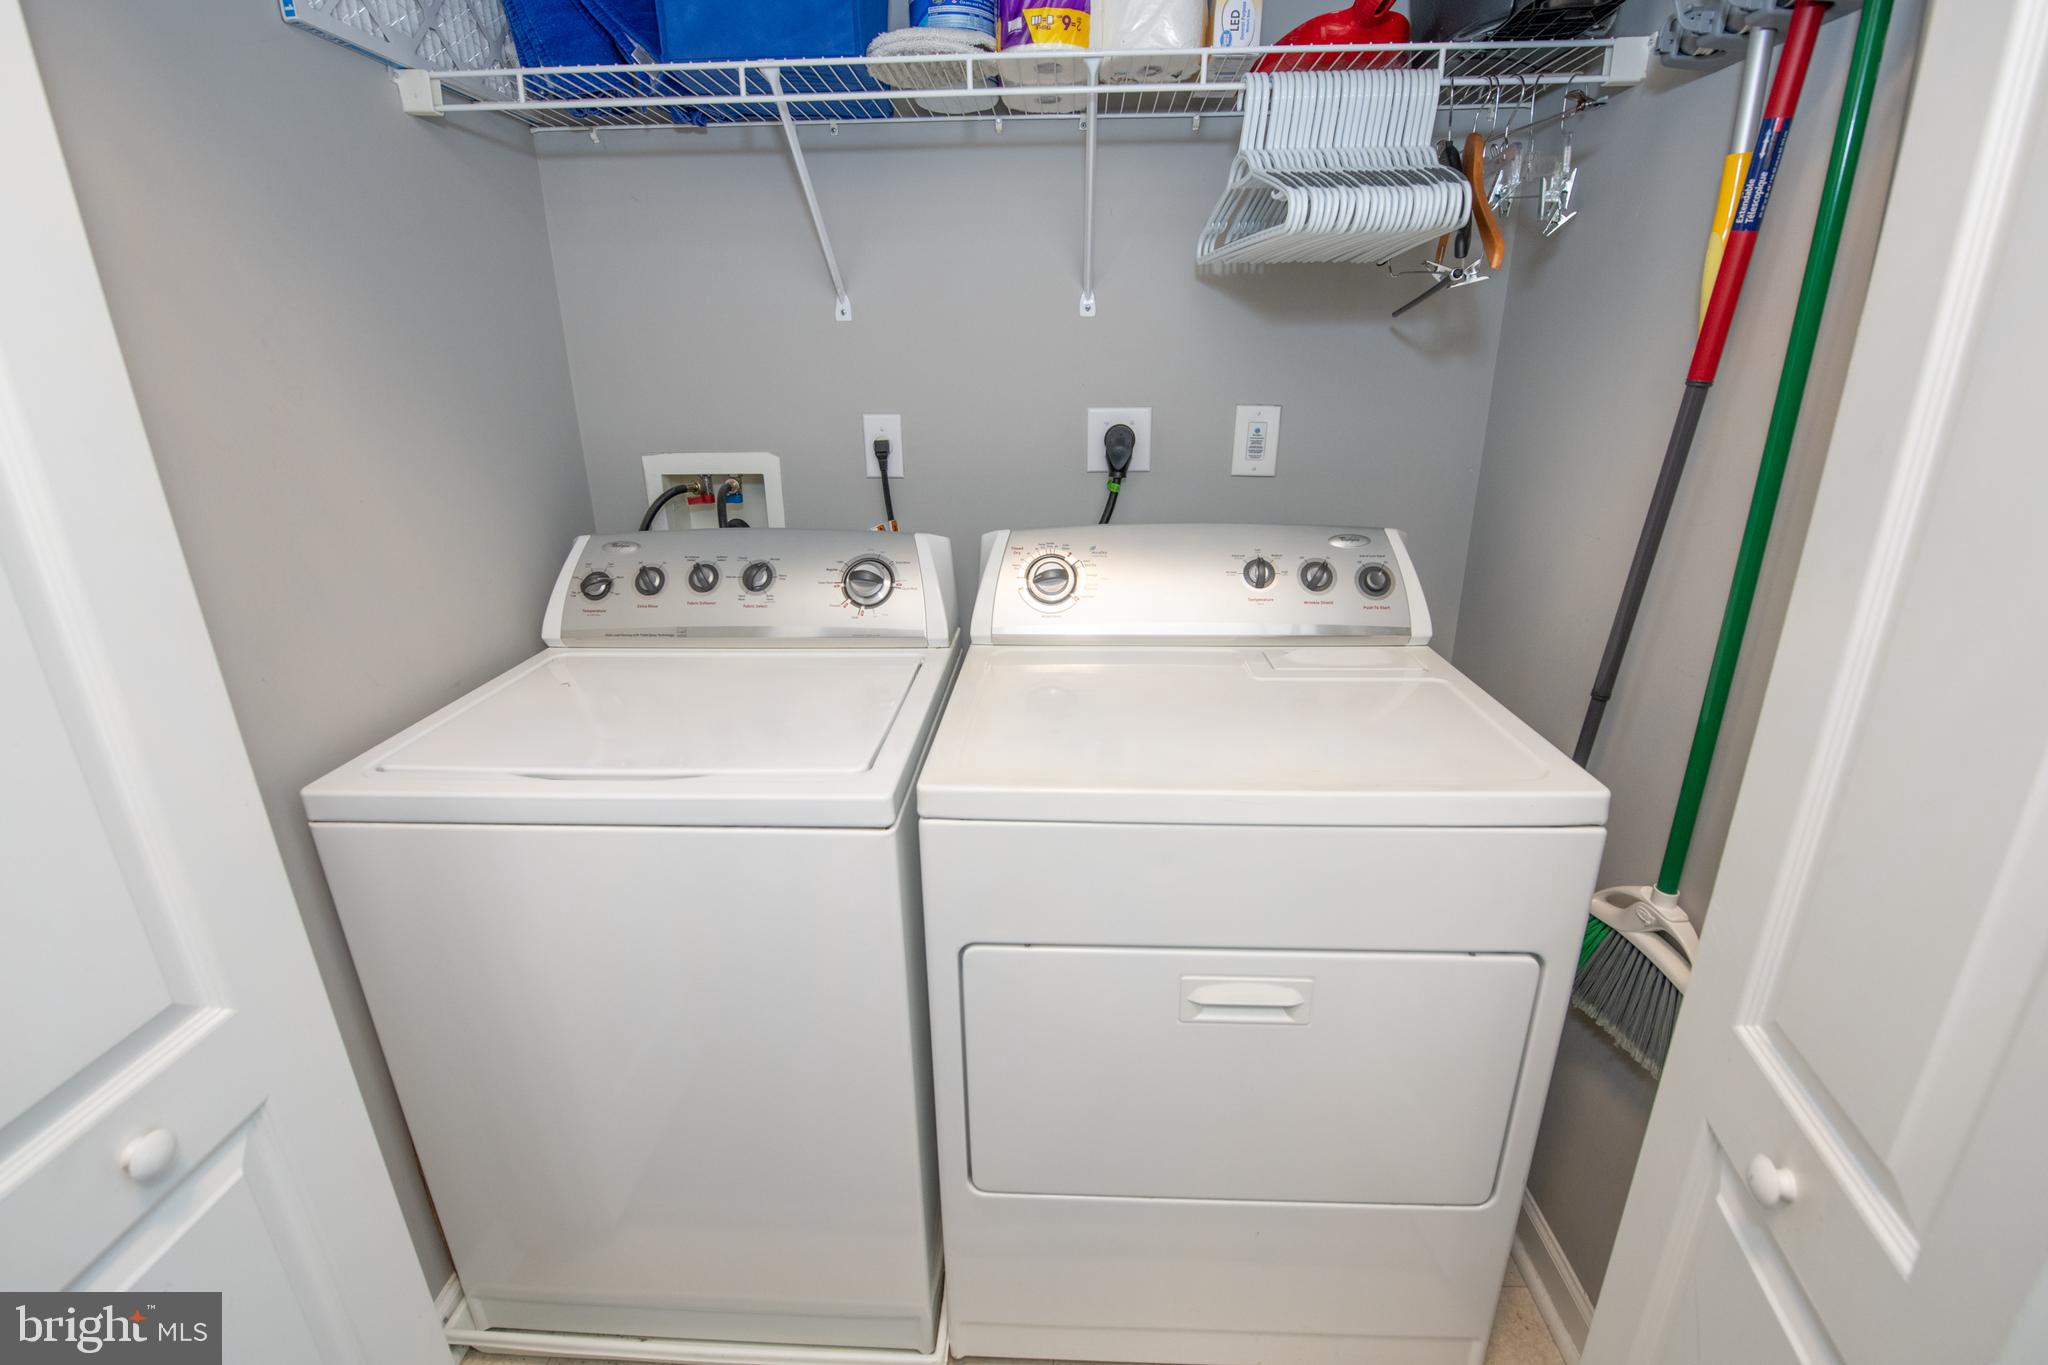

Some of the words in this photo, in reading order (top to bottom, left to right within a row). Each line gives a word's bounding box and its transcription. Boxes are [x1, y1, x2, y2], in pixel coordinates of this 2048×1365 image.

[1230, 9, 1240, 32] LED
[1735, 179, 1756, 224] Extendable
[1745, 171, 1768, 224] Télescopique
